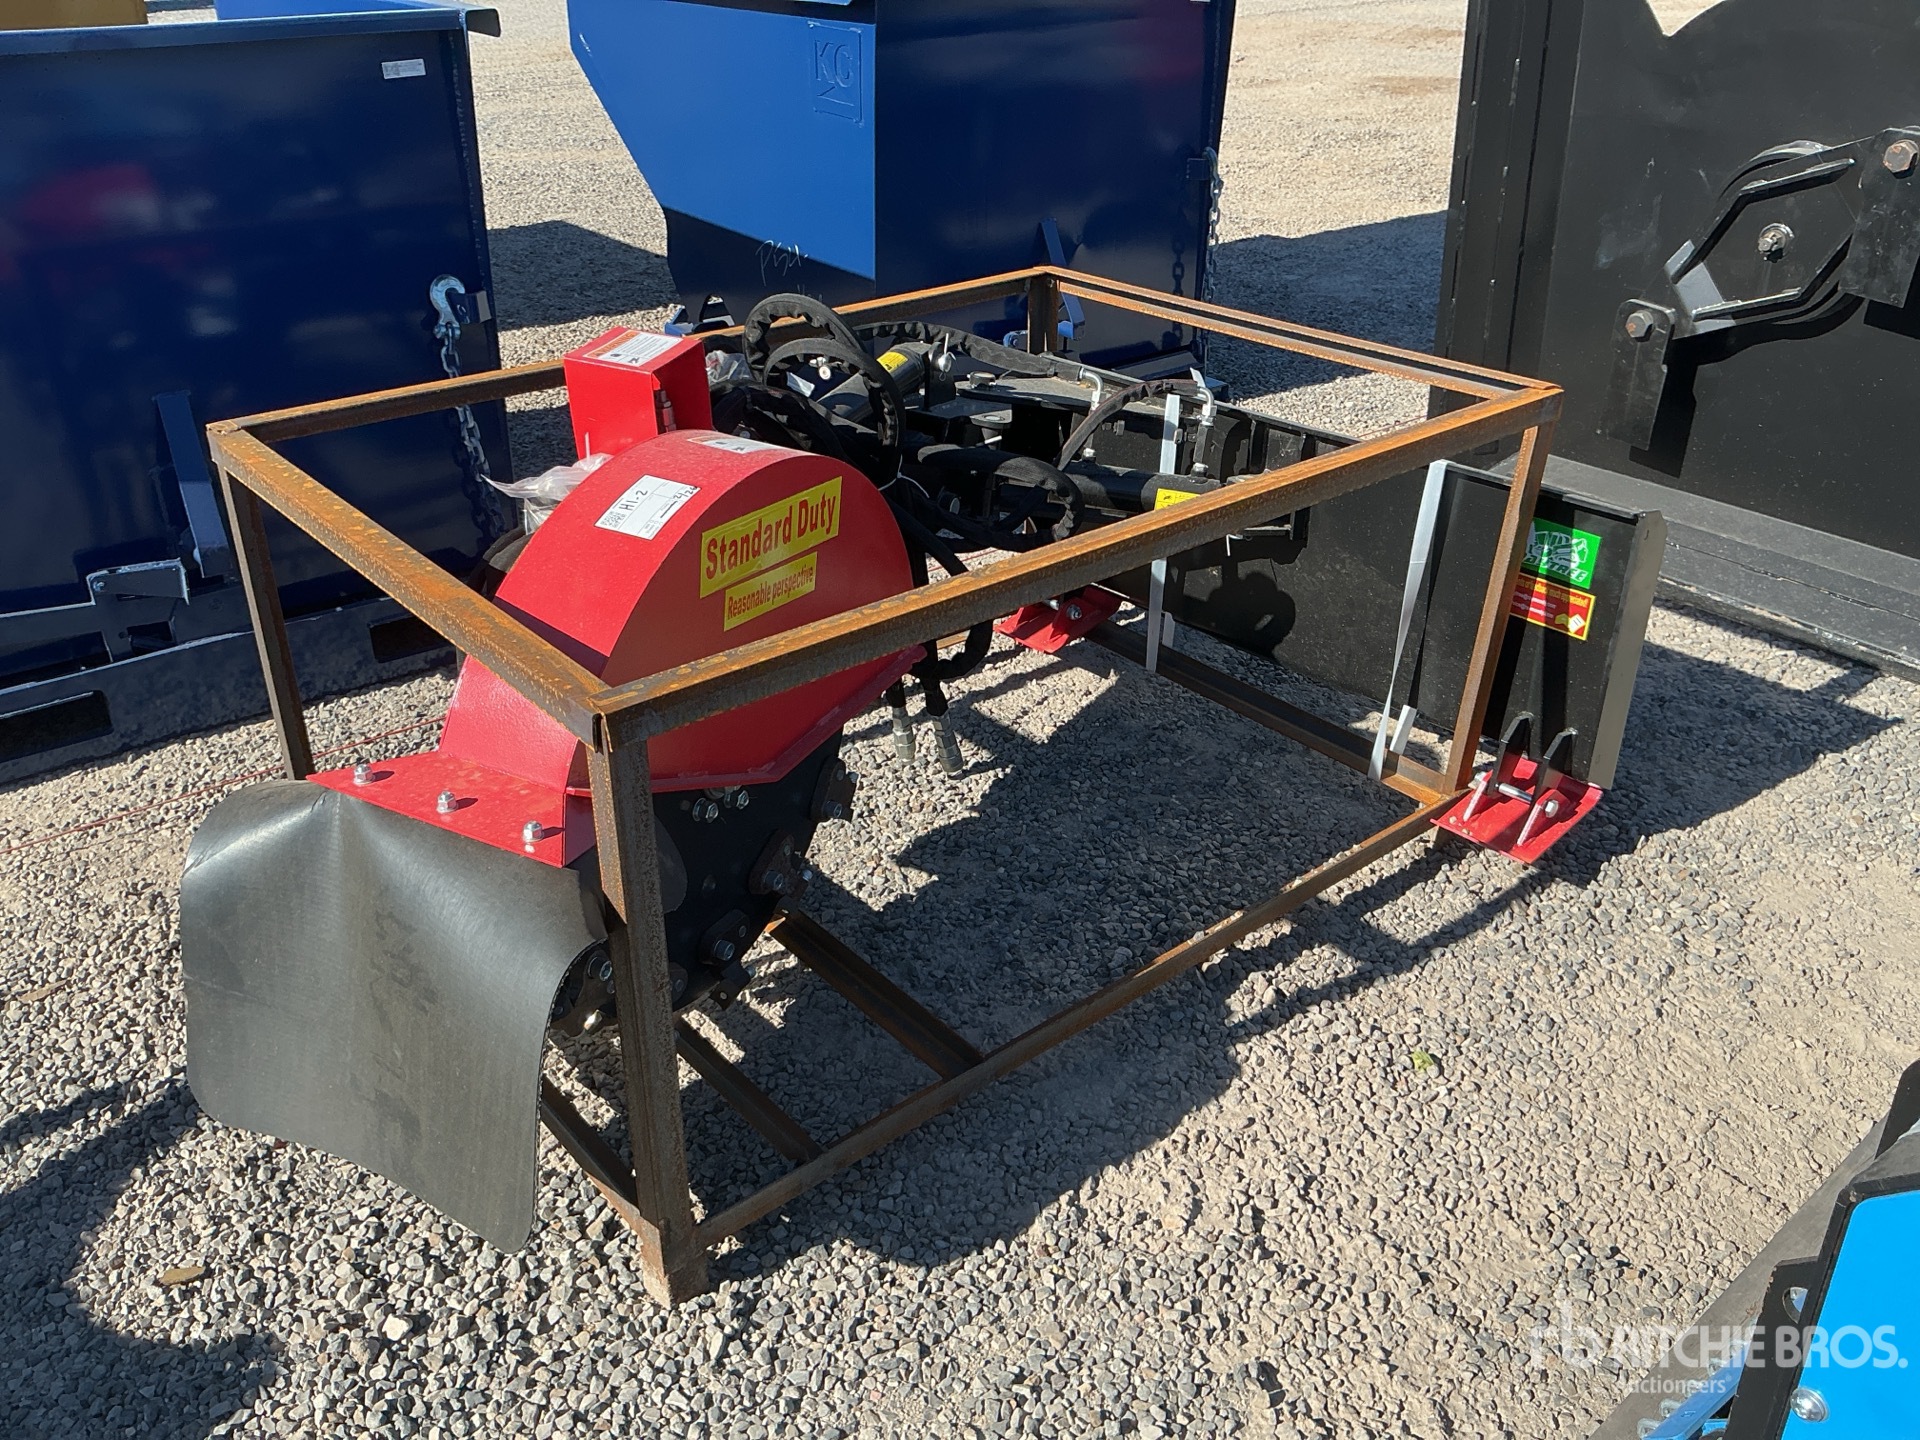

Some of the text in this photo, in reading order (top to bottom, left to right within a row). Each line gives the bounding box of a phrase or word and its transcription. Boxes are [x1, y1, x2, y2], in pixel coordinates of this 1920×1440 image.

[706, 492, 836, 580] Standard Duty
[727, 564, 814, 620] Reasonable perspective
